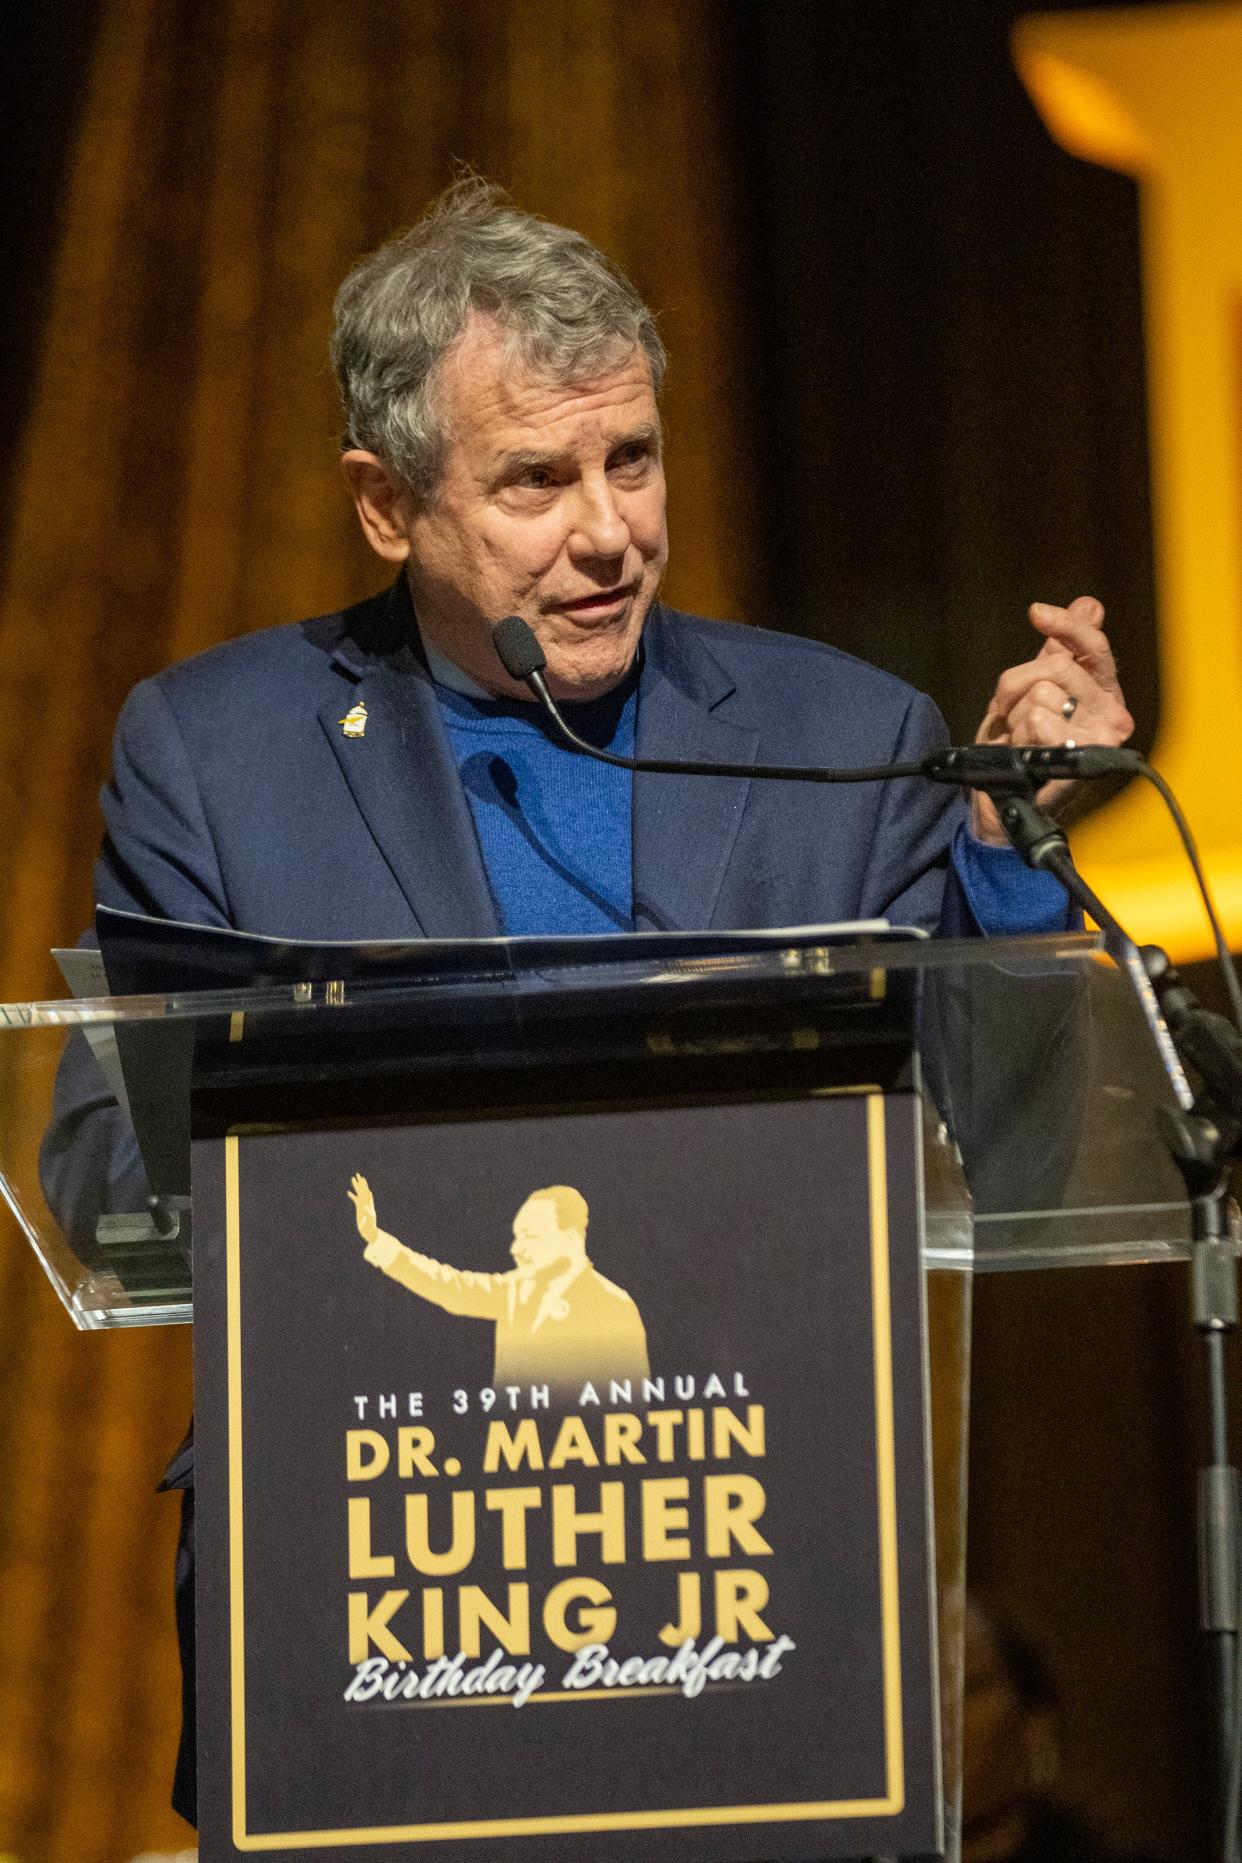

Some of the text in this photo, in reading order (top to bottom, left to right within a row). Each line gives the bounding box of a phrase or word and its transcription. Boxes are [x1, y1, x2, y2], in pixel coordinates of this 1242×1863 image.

[354, 1372, 750, 1420] THE 39TH ANNUAL
[346, 1404, 766, 1482] DR. MARTIN
[348, 1474, 774, 1579] LUTHER
[348, 1569, 776, 1665] KING JR
[344, 1634, 797, 1708] Birthday Breakfast
